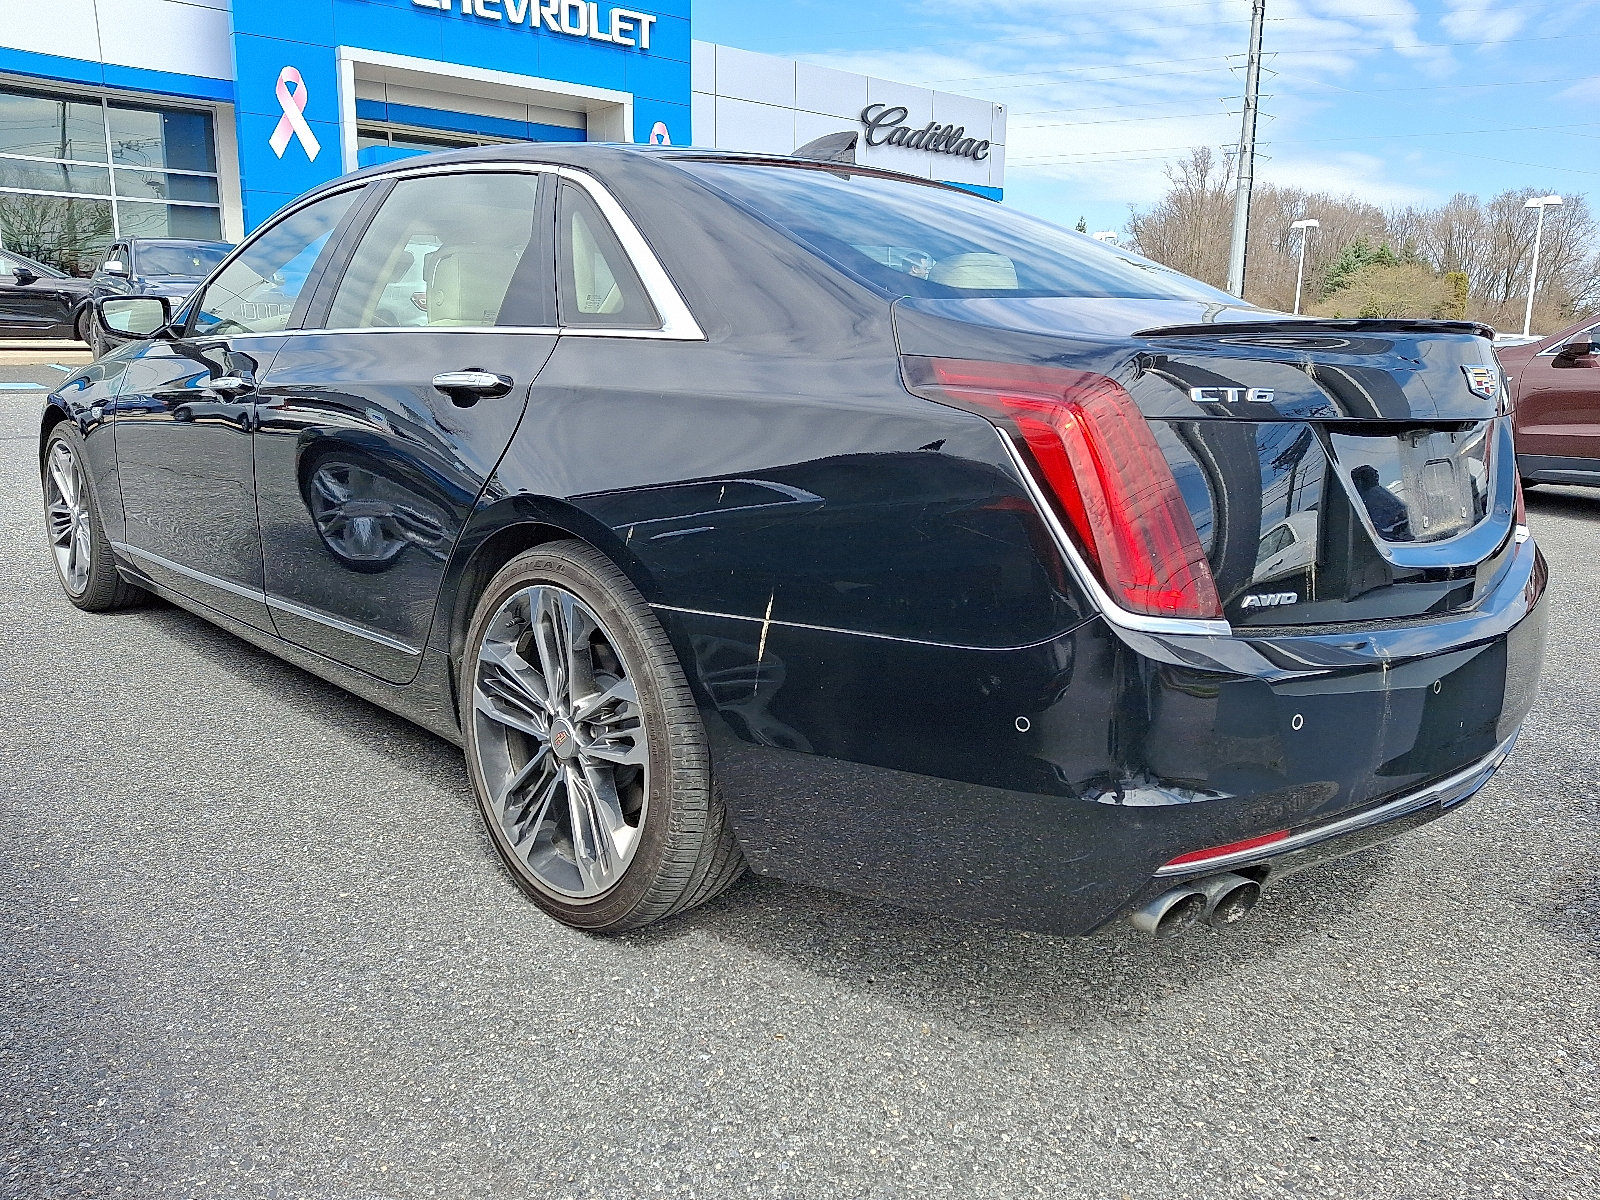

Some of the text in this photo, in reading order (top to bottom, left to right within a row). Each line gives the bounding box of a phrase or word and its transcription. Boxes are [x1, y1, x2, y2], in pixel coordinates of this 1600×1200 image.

[411, 0, 657, 50] VROLET
[861, 103, 990, 161] Cadillac
[1190, 387, 1275, 403] CT6
[1241, 592, 1298, 608] AWD
